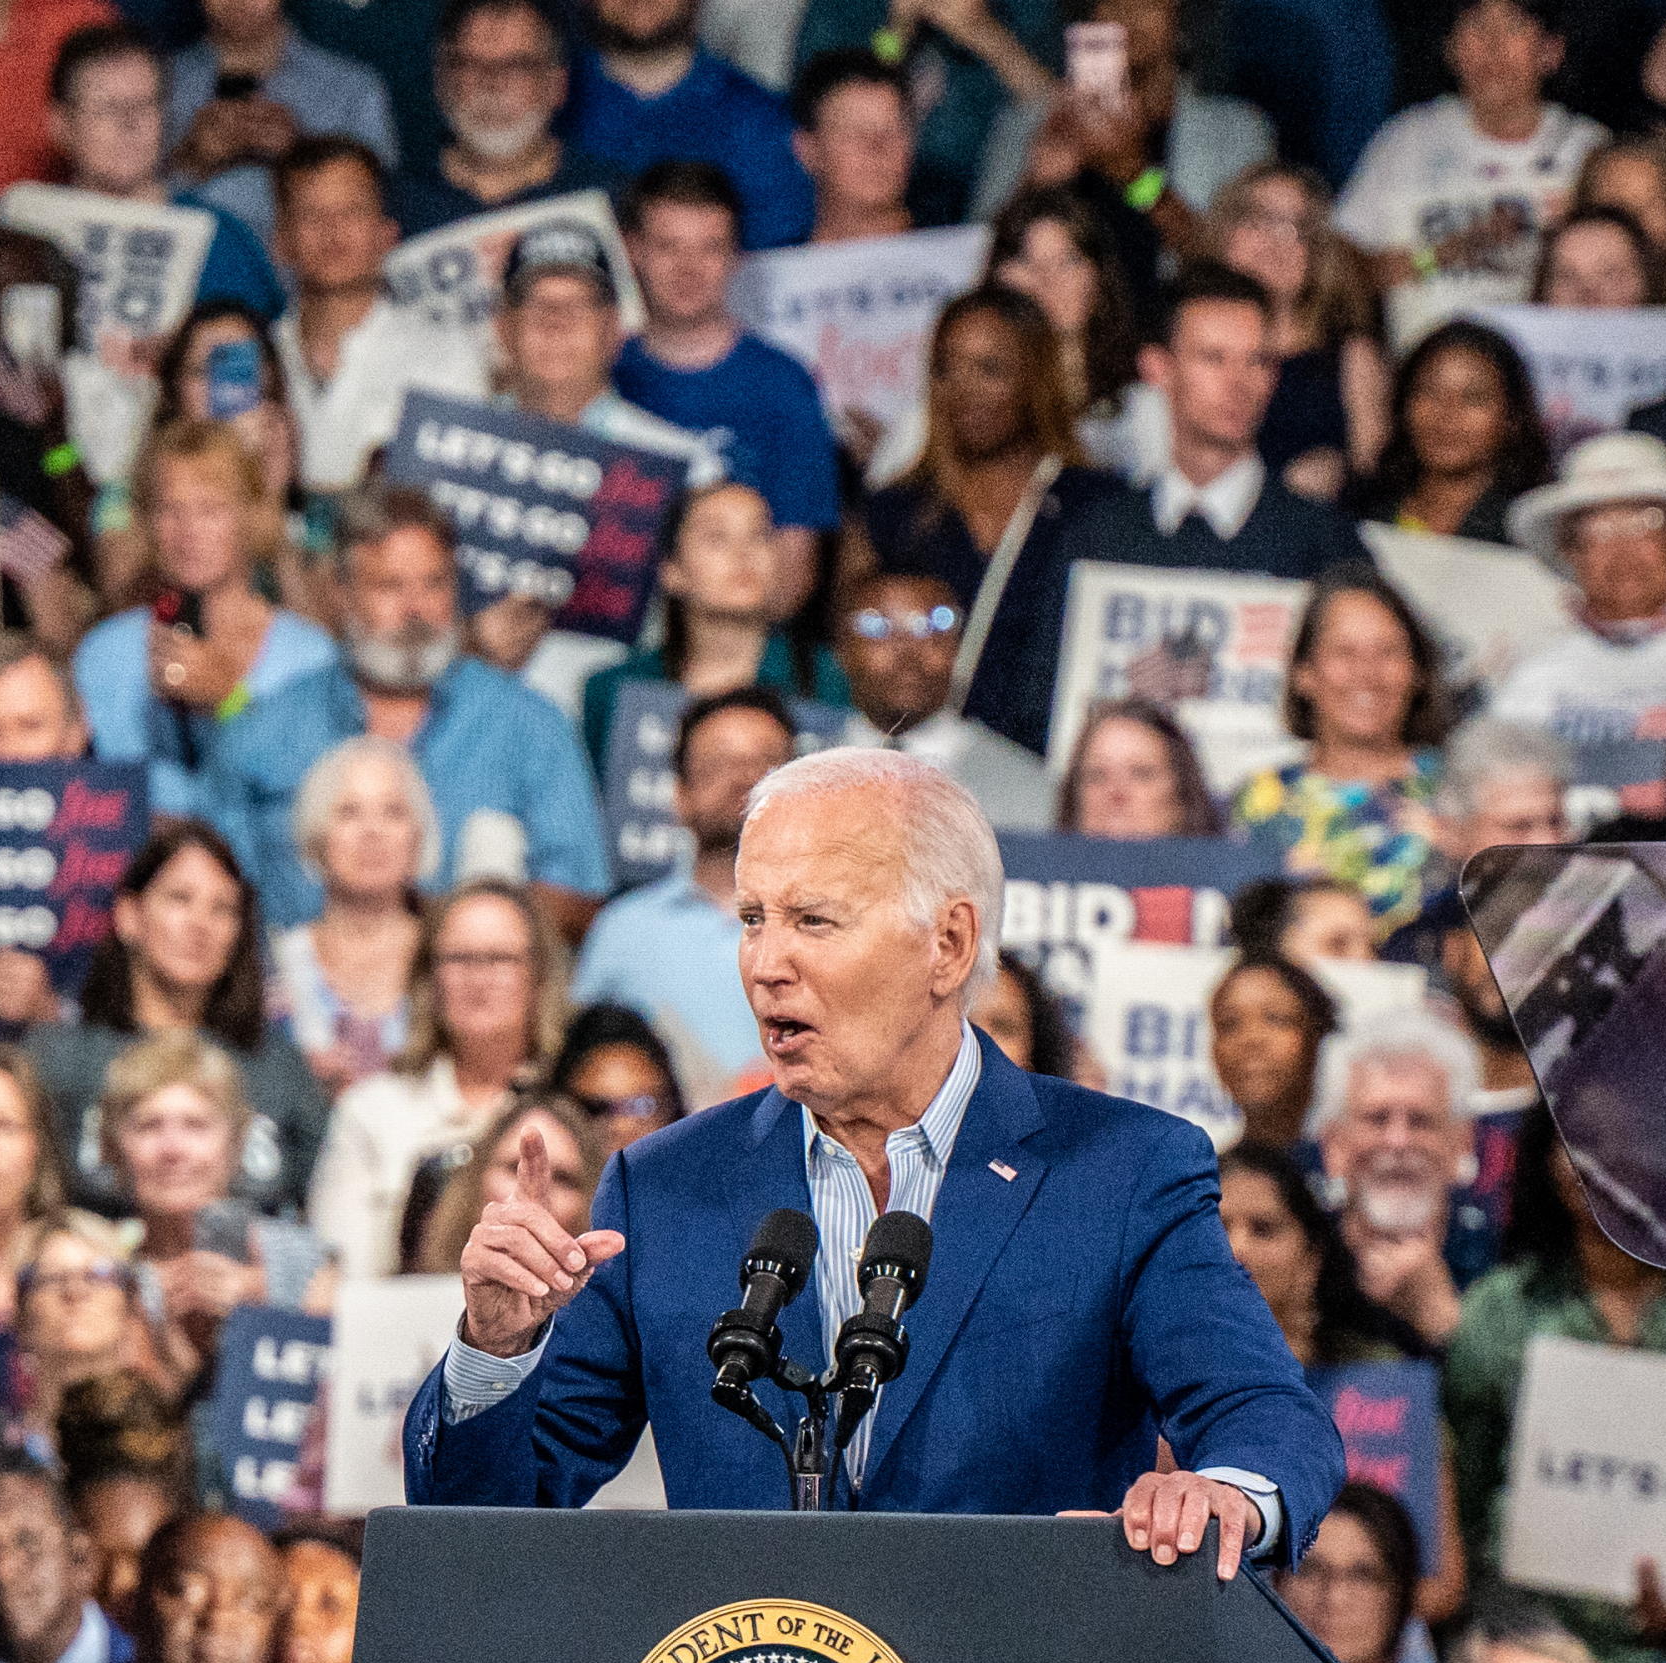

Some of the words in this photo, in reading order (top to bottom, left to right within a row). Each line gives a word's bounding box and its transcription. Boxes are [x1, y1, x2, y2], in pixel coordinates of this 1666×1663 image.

[1536, 1448, 1661, 1500] LET'S
[777, 1615, 805, 1637] OF
[814, 1622, 854, 1656] THE
